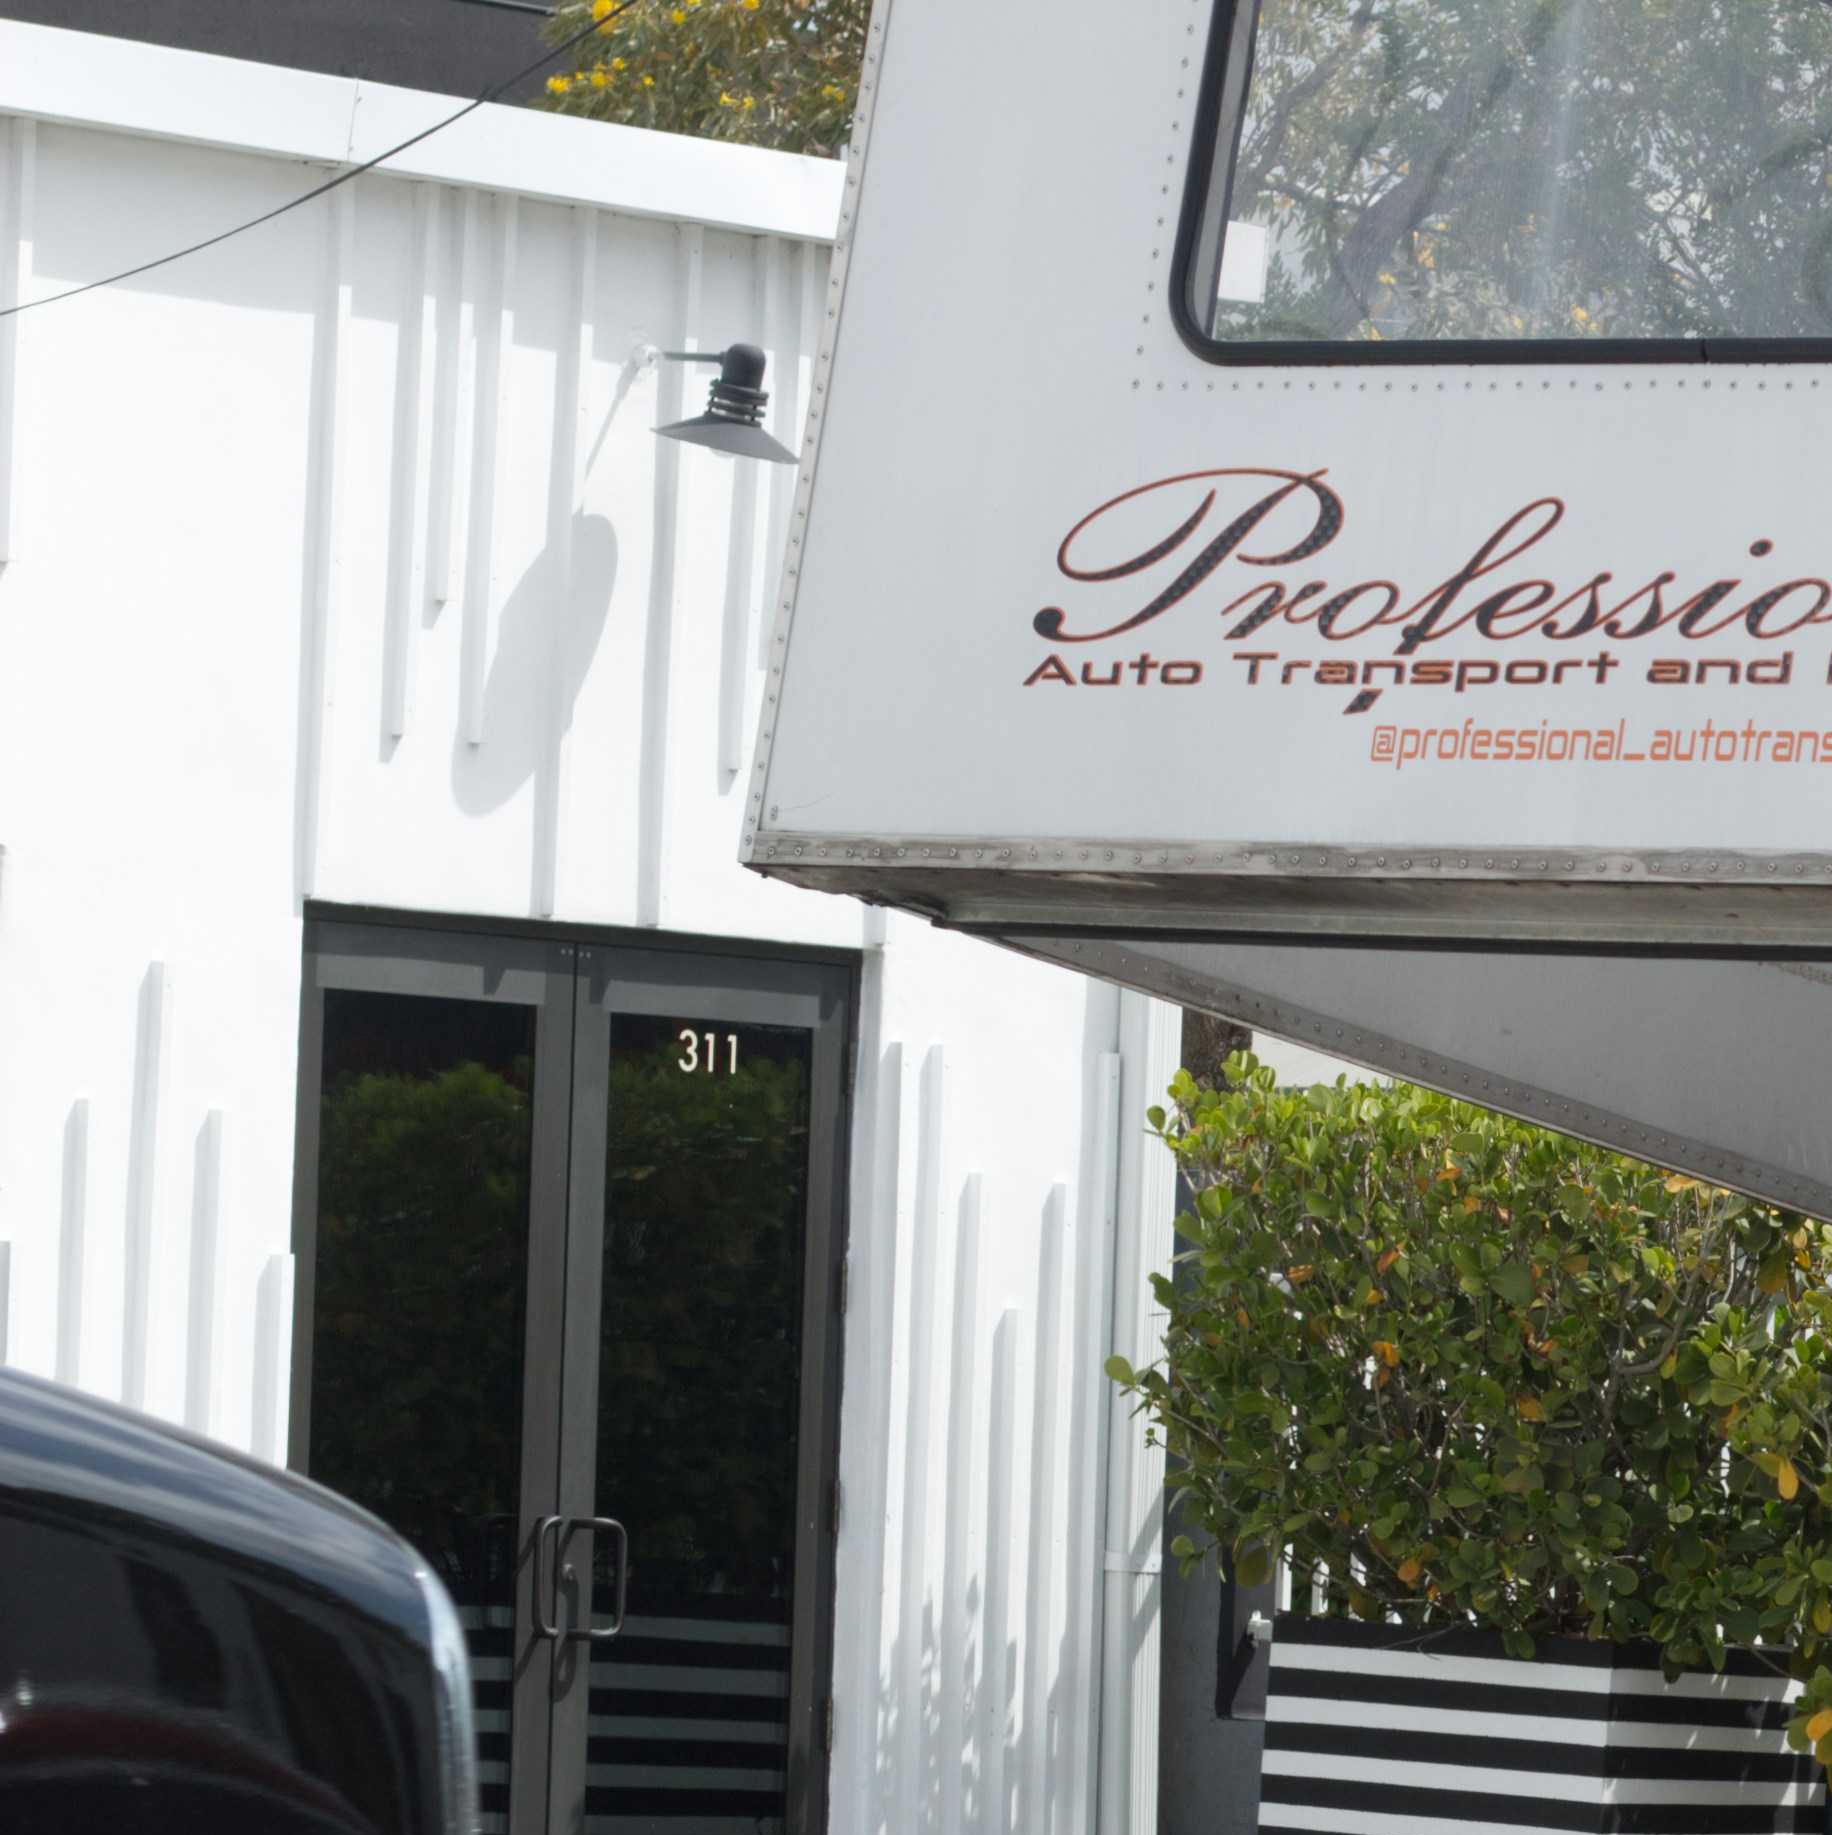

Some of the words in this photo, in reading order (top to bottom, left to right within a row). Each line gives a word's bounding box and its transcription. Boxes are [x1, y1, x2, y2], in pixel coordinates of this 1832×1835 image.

[1023, 653, 1202, 686] Auto
[1240, 652, 1618, 692] Transport
[1646, 652, 1794, 687] and
[678, 1029, 737, 1075] 311
